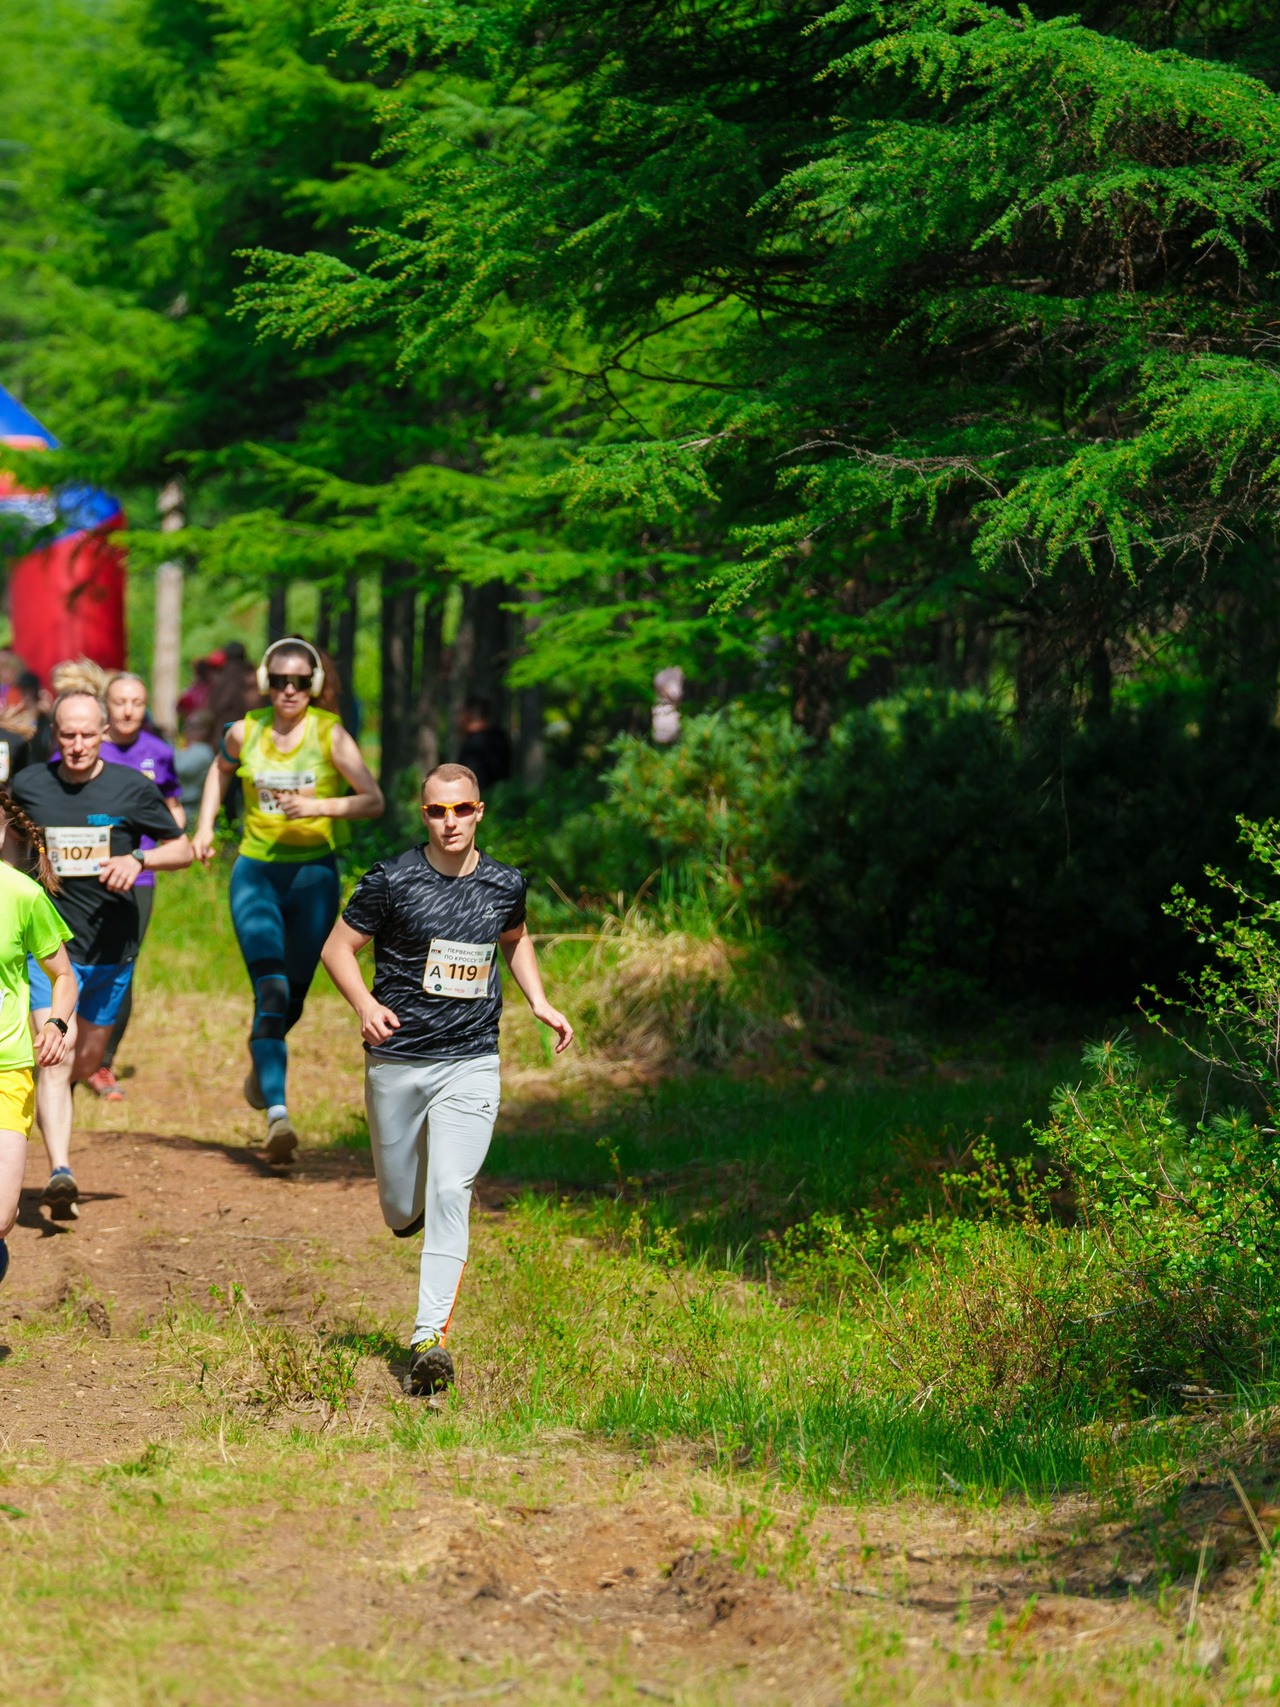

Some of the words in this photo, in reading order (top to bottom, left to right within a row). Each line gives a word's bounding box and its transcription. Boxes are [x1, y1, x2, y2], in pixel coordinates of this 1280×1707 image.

[63, 846, 93, 860] 107
[447, 947, 484, 956] ПЕРВЕНСТВО
[454, 956, 477, 964] КРОССУ
[449, 963, 478, 982] 119
